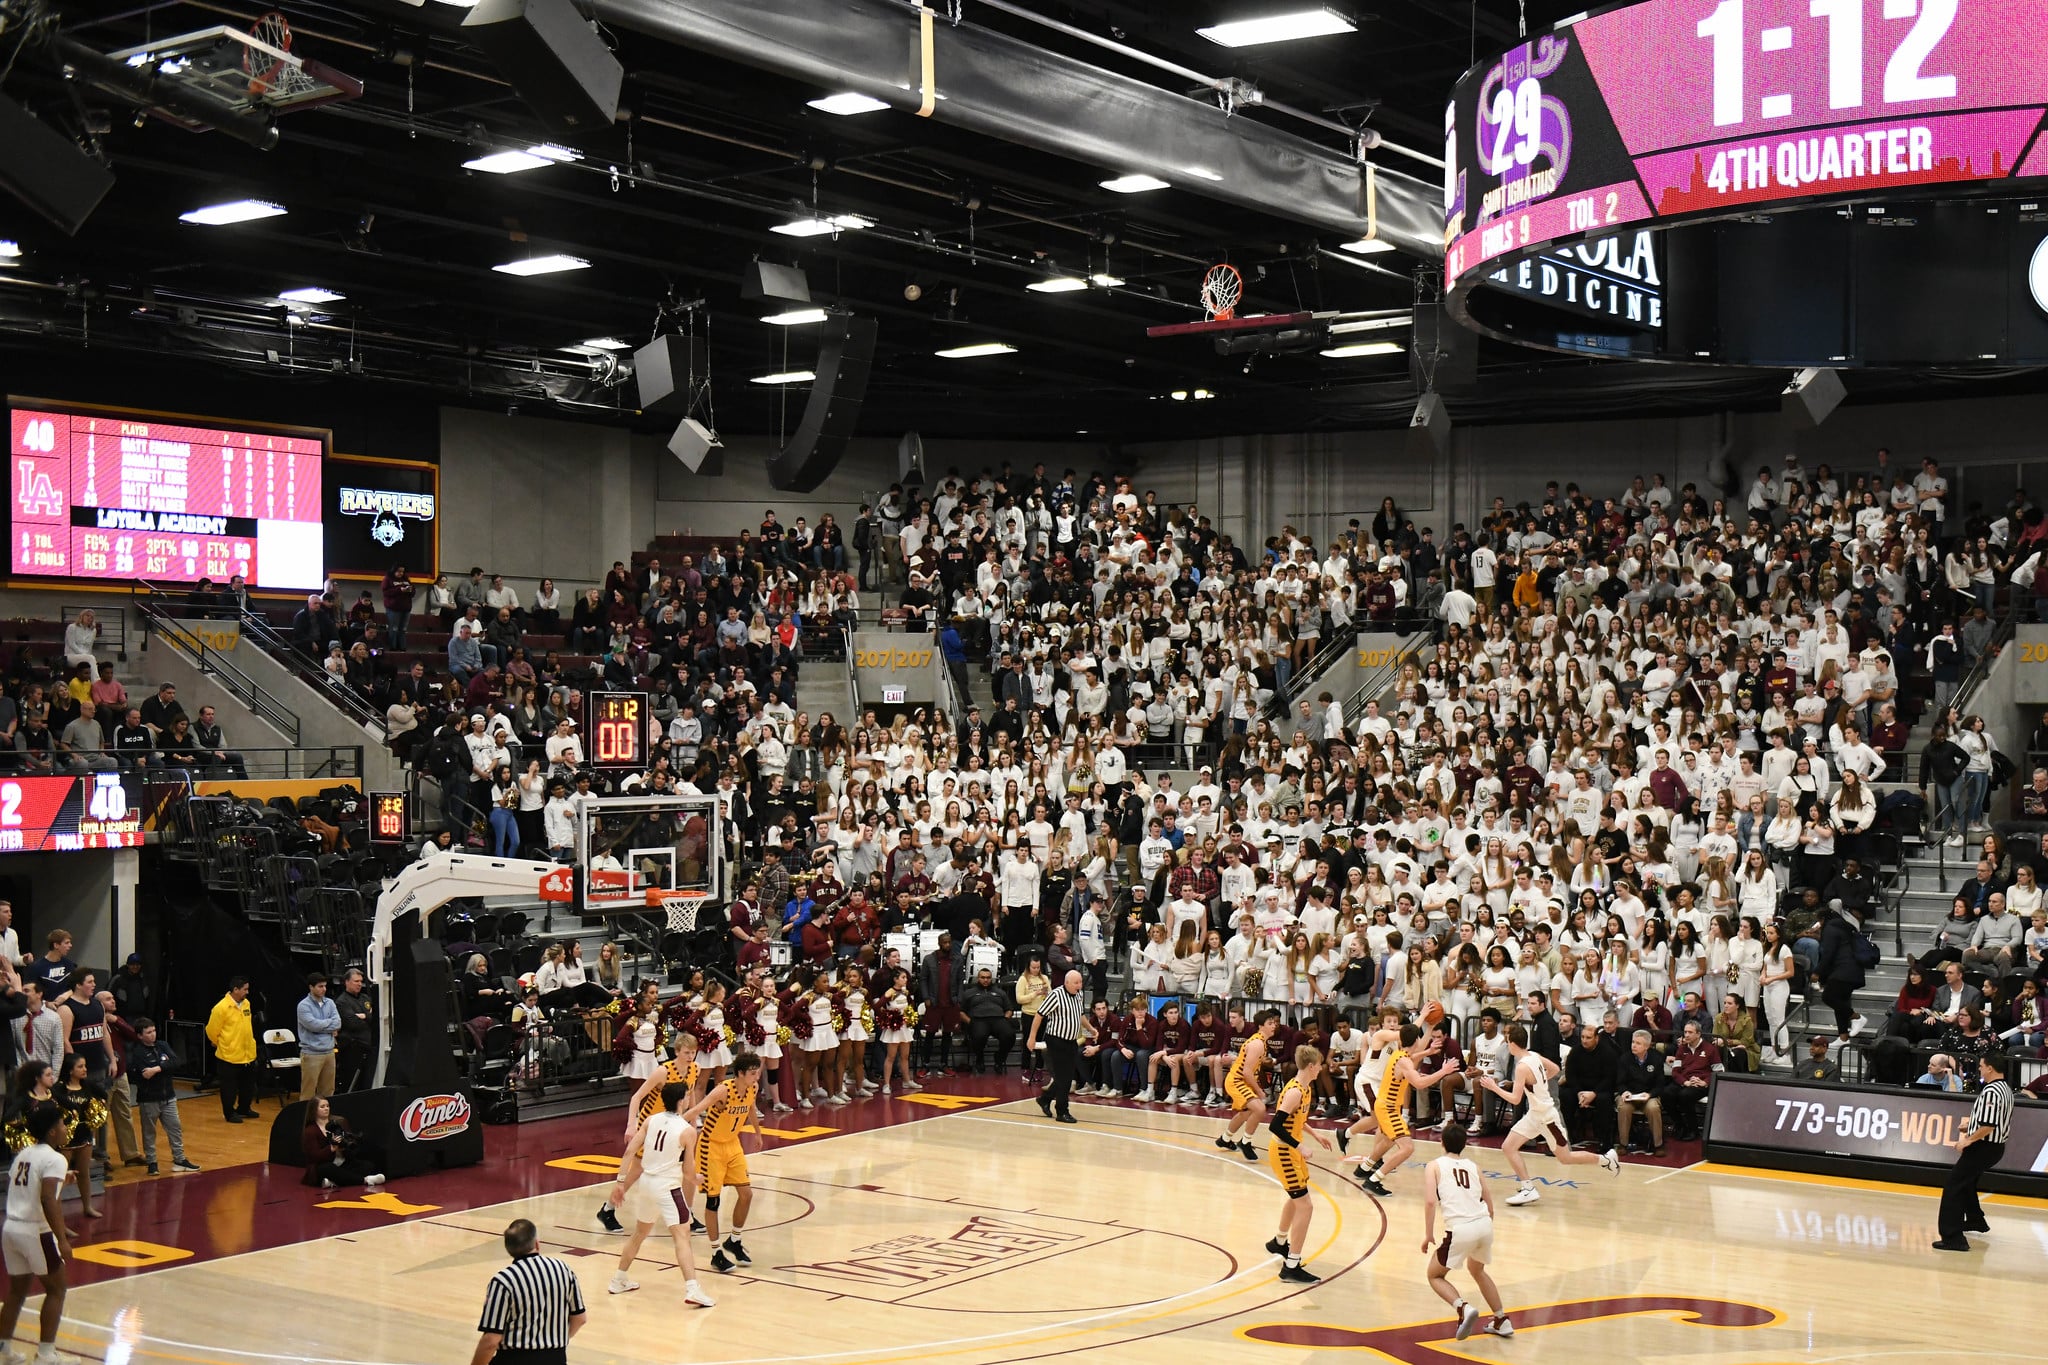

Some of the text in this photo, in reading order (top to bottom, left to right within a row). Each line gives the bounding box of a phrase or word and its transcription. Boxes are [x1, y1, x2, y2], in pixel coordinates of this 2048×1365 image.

[1697, 0, 1957, 128] 1:12
[1491, 77, 1542, 177] 29
[1707, 126, 1934, 196] 4TH QUARTER
[1481, 219, 1514, 259] FOULS
[1519, 214, 1530, 244] 9
[1566, 196, 1599, 231] TOL
[1604, 191, 1618, 223] 2
[22, 418, 55, 453] 40
[121, 423, 148, 437] PLAYER
[223, 433, 229, 445] P
[267, 438, 273, 449] A
[287, 440, 293, 451] F
[340, 487, 435, 520] RAMBLERS
[97, 507, 228, 535] LOYOLA ACADEMY
[34, 533, 54, 549] TOL
[84, 534, 110, 552] FG%
[115, 535, 134, 555] 47
[146, 538, 178, 557] 3PT%
[207, 541, 230, 559] FT%
[34, 551, 66, 567] FOULS
[84, 552, 107, 571] REB
[146, 556, 168, 574] AST
[207, 560, 228, 577] BLK
[886, 690, 904, 702] EXIT
[608, 699, 639, 721] 1:12
[599, 723, 633, 759] 00
[90, 785, 126, 821] 40
[78, 820, 140, 834] LOYOLA ACADEMY
[381, 815, 399, 834] 00
[90, 833, 97, 848] 4
[127, 832, 135, 847] 3
[392, 892, 417, 919] SPALDING
[1774, 1099, 1971, 1148] 773-508-WOL
[653, 1129, 668, 1152] 11
[14, 1161, 31, 1187] 23
[1452, 1167, 1471, 1190] 10
